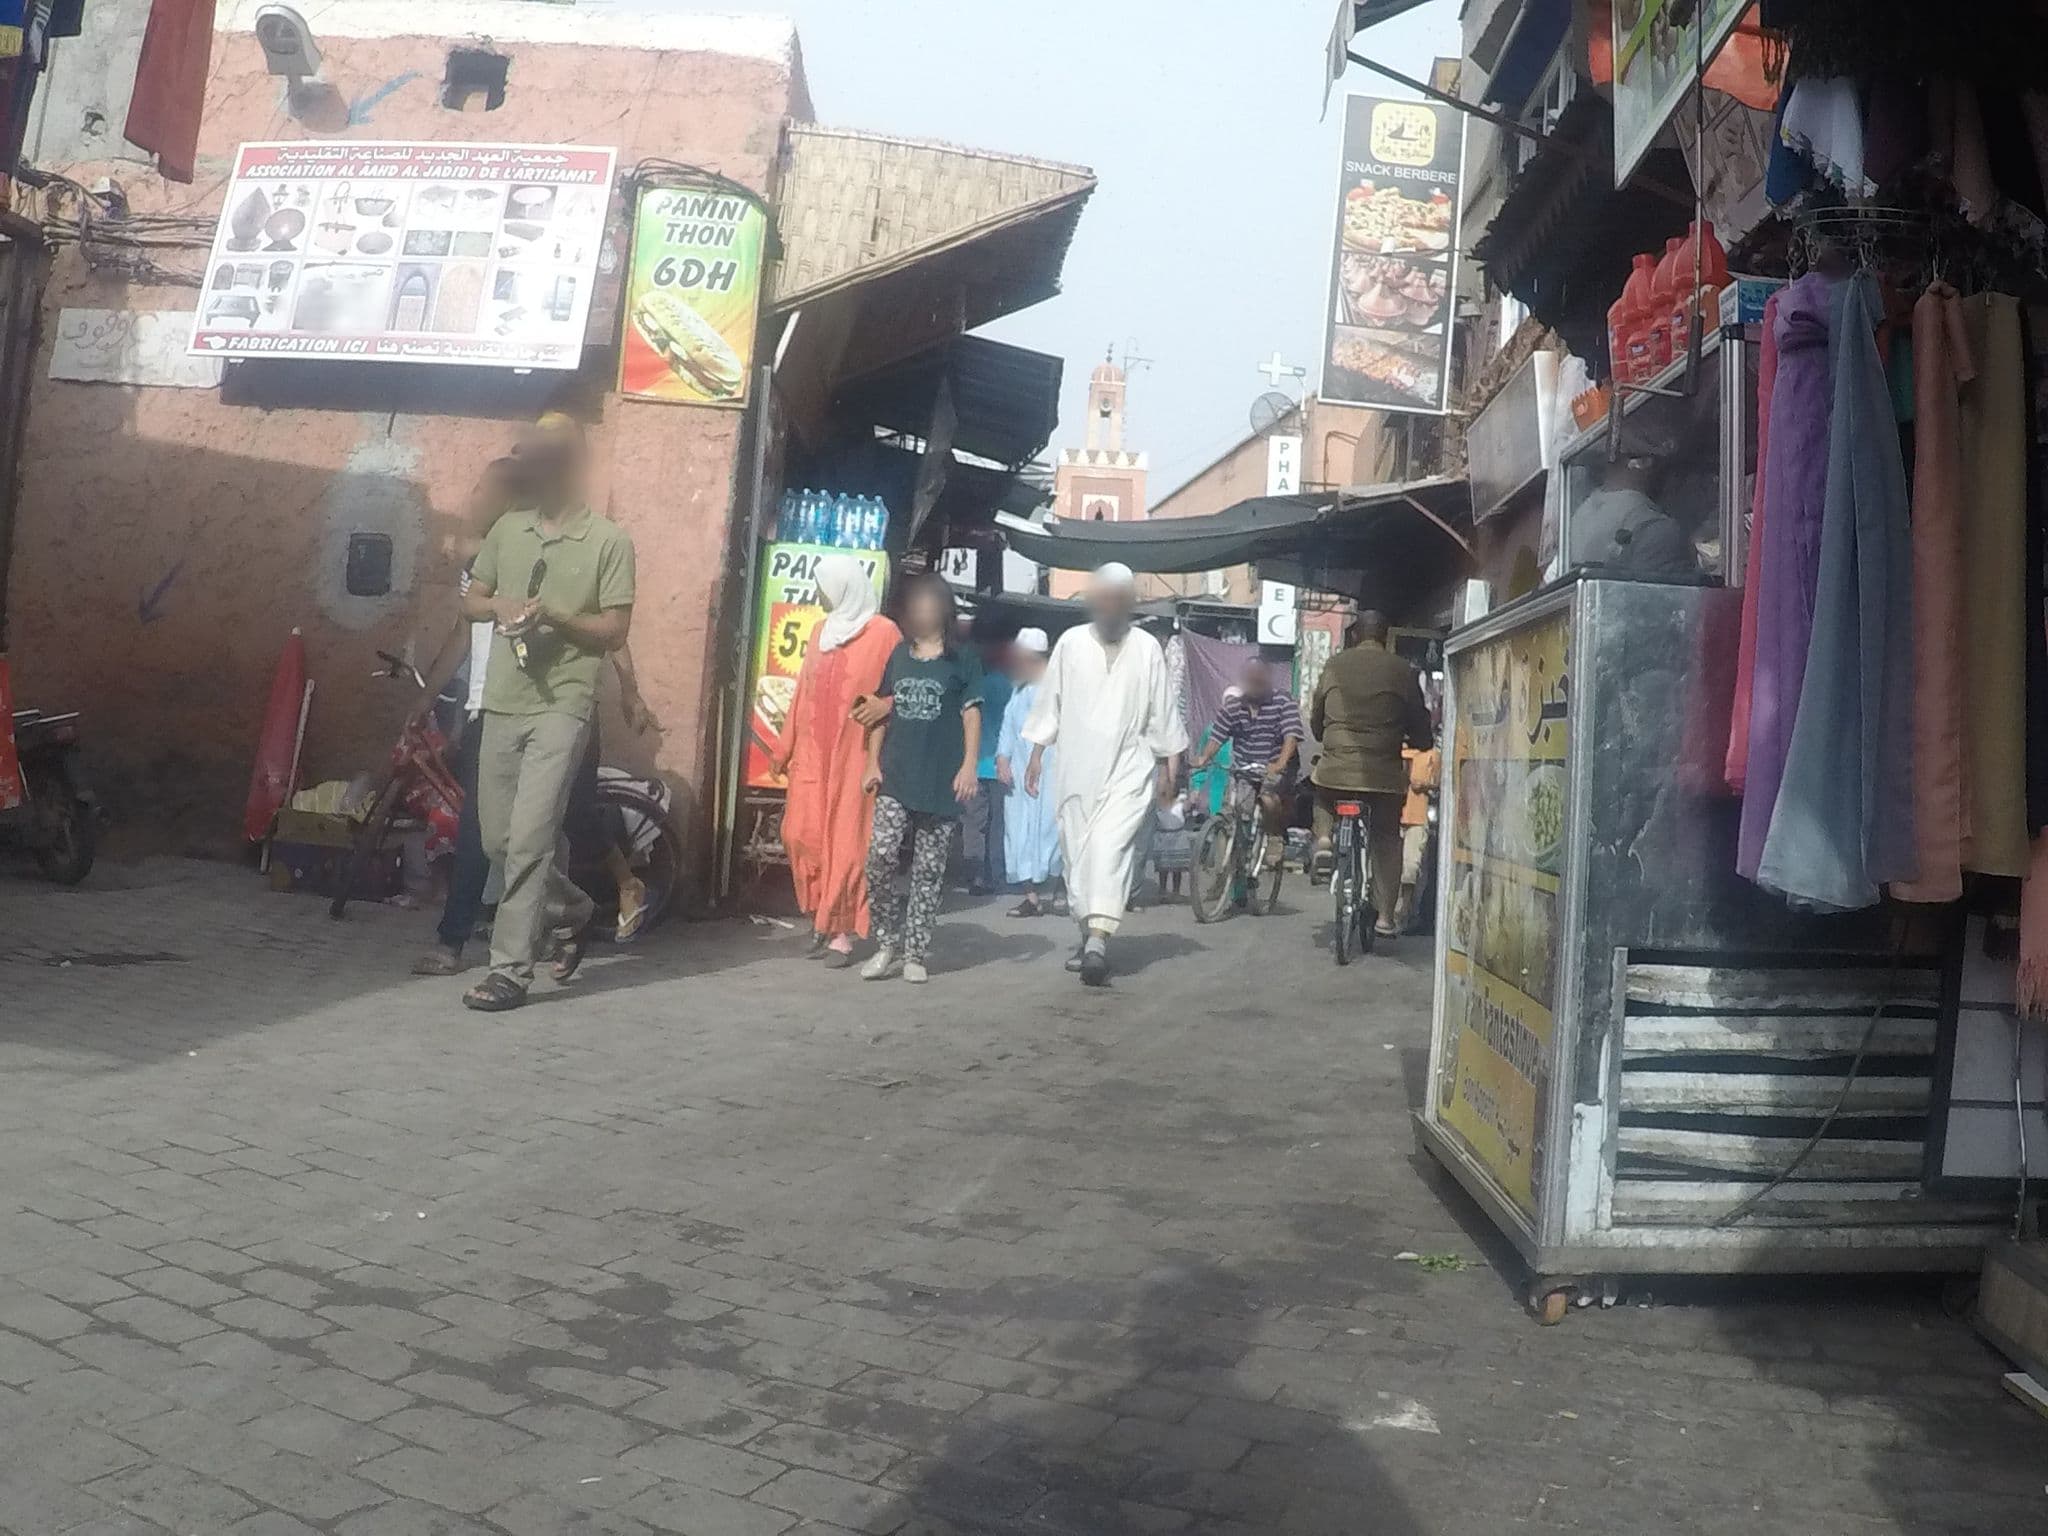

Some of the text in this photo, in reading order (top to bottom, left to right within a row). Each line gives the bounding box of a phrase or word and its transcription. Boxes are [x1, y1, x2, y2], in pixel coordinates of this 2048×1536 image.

[246, 164, 338, 178] ASSOCIATION
[338, 164, 355, 177] AL
[401, 165, 420, 178] AL
[423, 165, 475, 179] JADIDI
[478, 166, 498, 181] DE
[503, 167, 598, 184] L'ARTISANAT
[1345, 160, 1457, 185] SNACK BERBERE
[655, 195, 751, 222] PANINI
[665, 223, 736, 247] THON
[653, 257, 738, 291] 6DH
[228, 336, 370, 353] FABRICATION ICI
